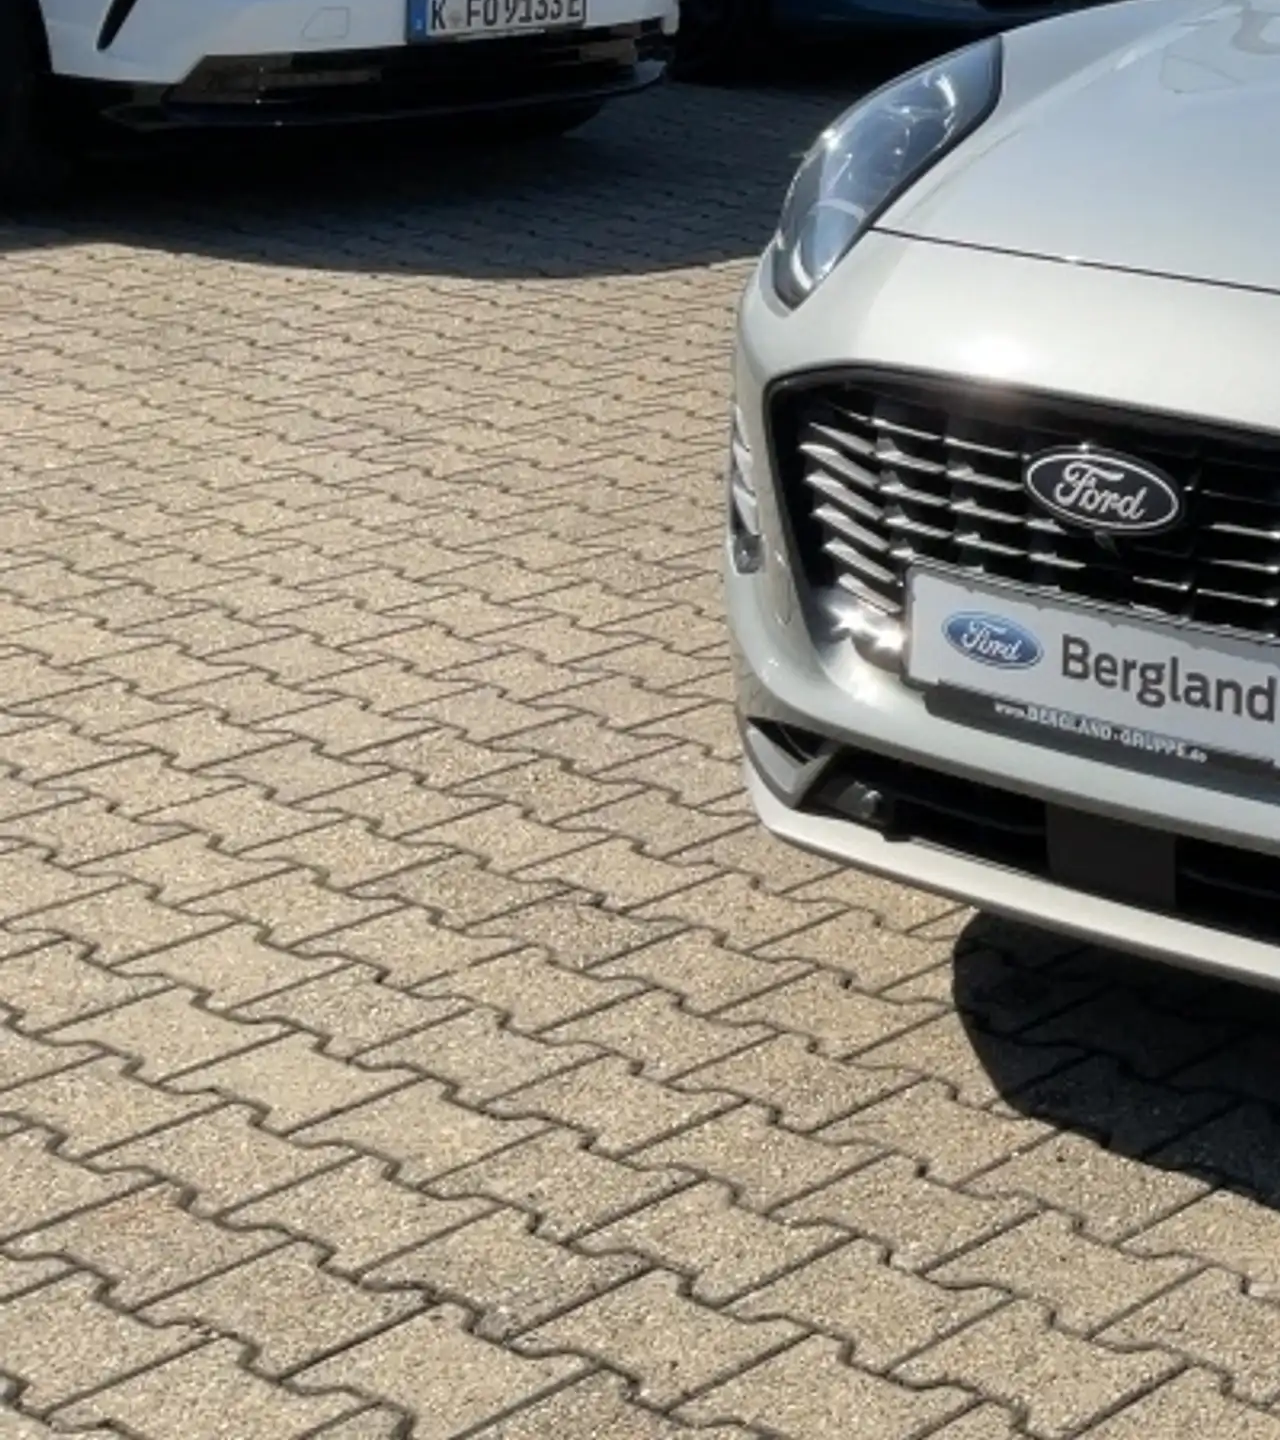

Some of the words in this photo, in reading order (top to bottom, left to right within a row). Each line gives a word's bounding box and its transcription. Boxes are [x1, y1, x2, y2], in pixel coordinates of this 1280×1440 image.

[1054, 461, 1148, 520] Ford
[958, 619, 1023, 660] Ford
[1061, 633, 1278, 724] Bergland
